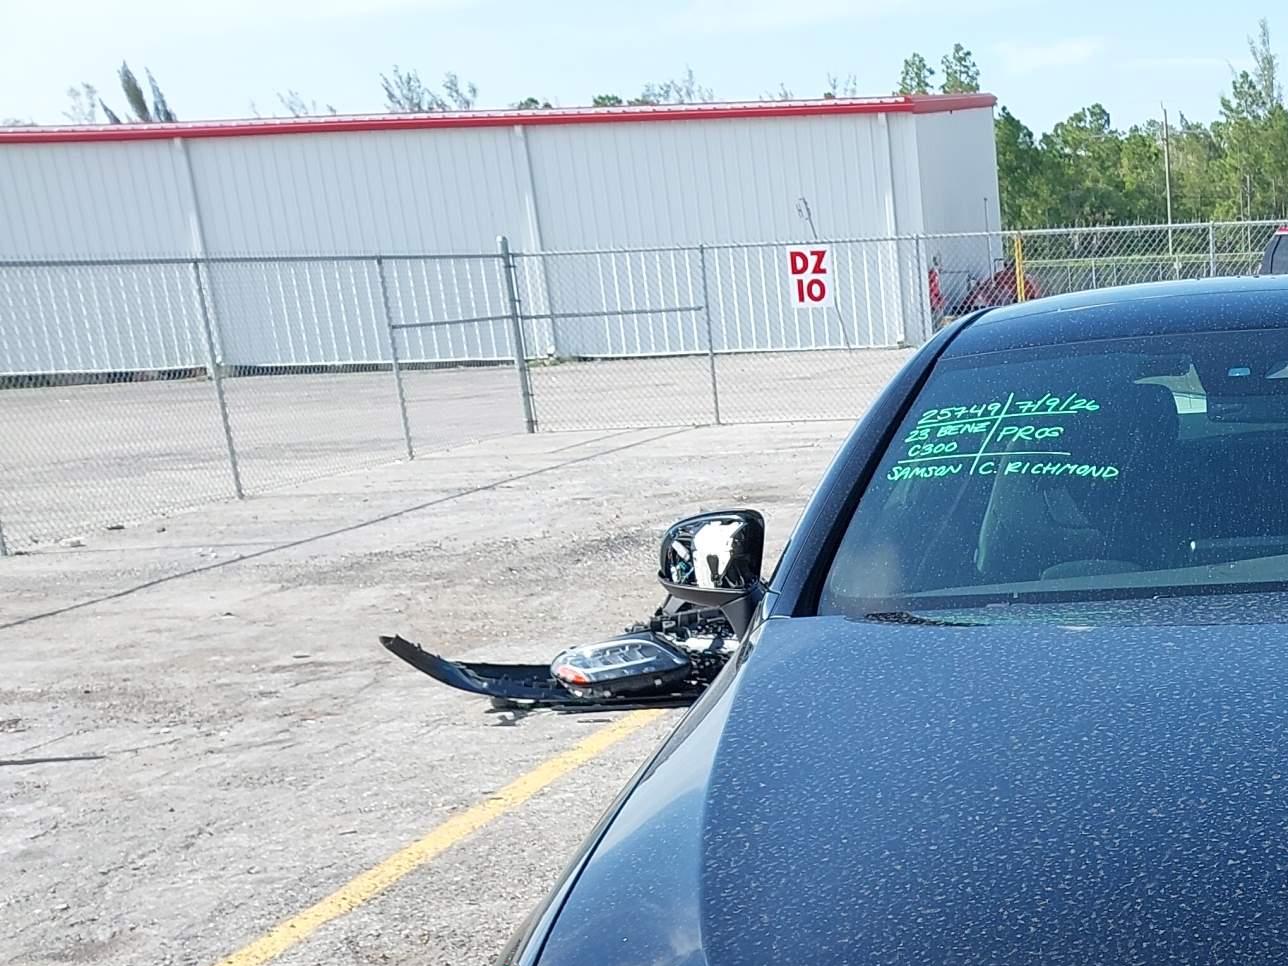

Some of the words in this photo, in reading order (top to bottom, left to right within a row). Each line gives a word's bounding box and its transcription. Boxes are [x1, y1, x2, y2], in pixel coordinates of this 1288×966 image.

[789, 249, 828, 275] DZ
[1014, 392, 1100, 413] 7/9/26
[917, 402, 1002, 425] 25749
[904, 428, 931, 443] 23
[908, 441, 958, 457] C300
[887, 463, 963, 481] SAMSON
[1004, 460, 1120, 479] RICHMOND
